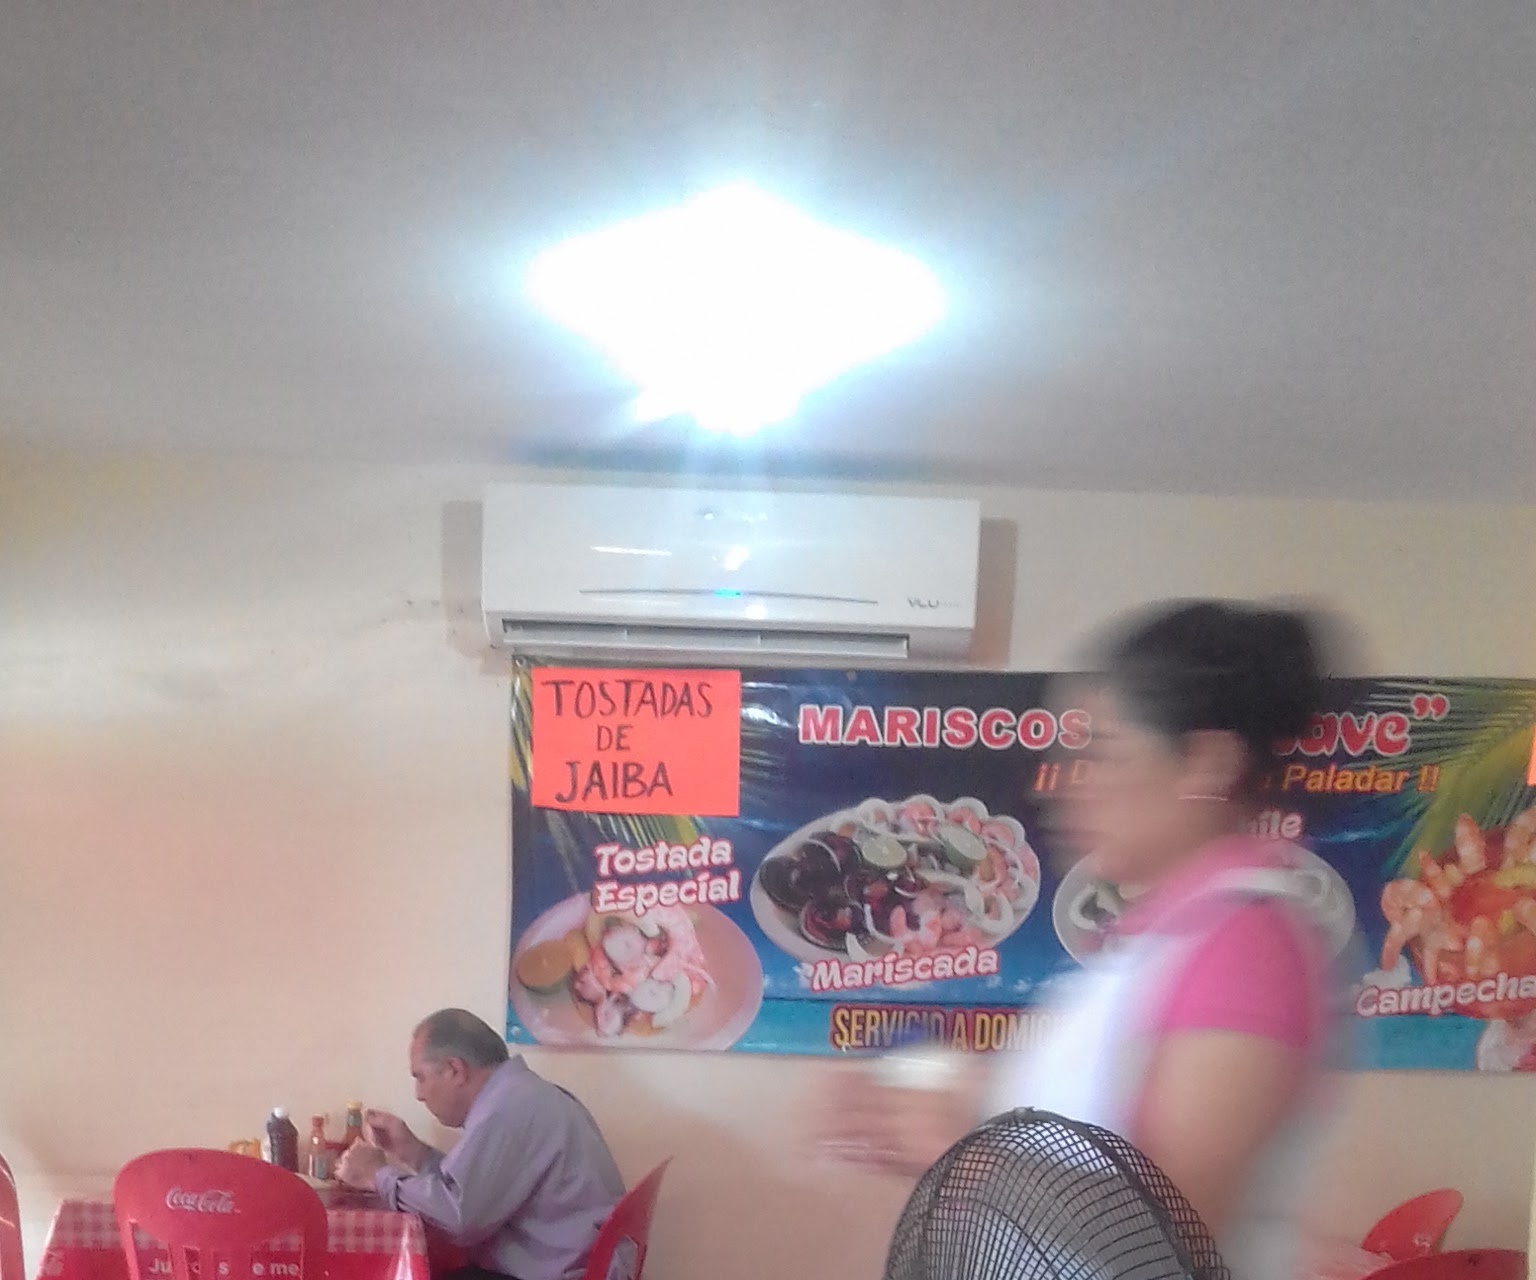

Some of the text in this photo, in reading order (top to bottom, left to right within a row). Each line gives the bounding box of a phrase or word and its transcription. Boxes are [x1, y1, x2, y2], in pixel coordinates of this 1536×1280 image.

[541, 679, 714, 720] TOSTADAS
[596, 724, 634, 752] DE
[798, 704, 1093, 750] MARISCOS
[554, 760, 674, 804] JAIBA
[1281, 763, 1412, 793] Paladar
[1247, 810, 1304, 840] ile
[594, 833, 735, 878] Tostada
[592, 867, 743, 918] Especial
[810, 945, 1000, 994] Mariscada
[1356, 970, 1536, 1018] Campecha
[953, 1011, 969, 1051] A
